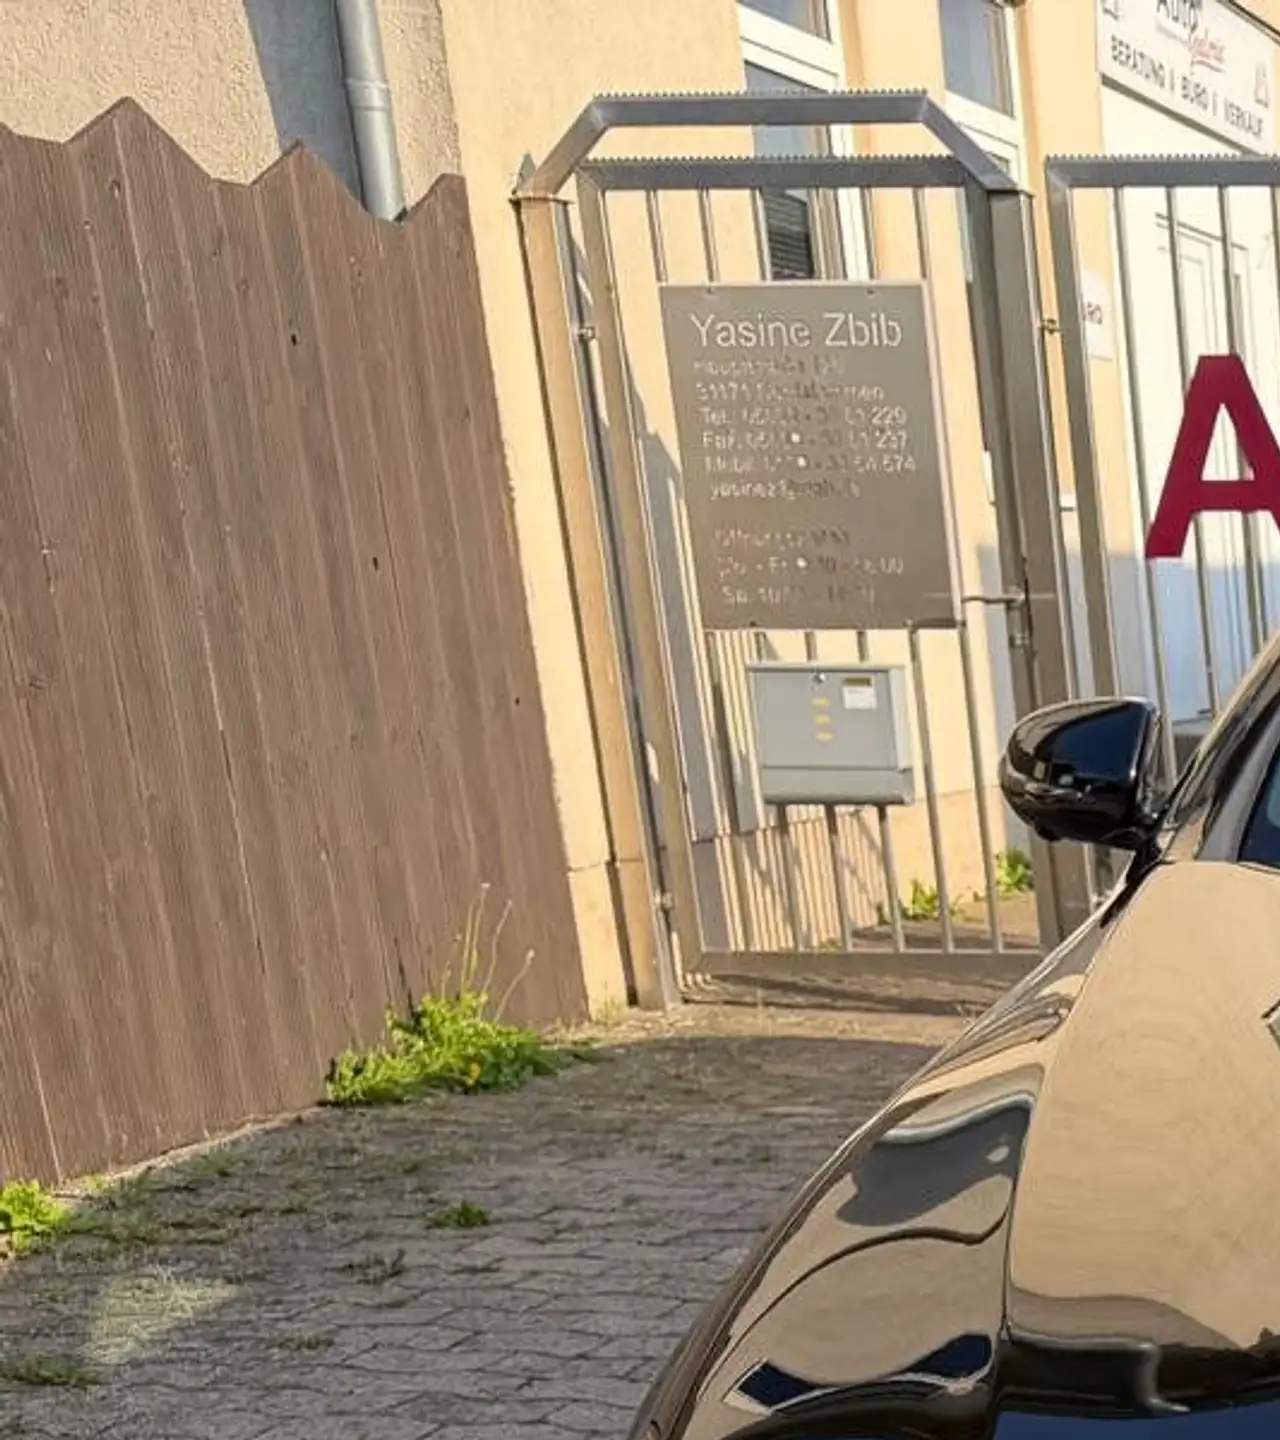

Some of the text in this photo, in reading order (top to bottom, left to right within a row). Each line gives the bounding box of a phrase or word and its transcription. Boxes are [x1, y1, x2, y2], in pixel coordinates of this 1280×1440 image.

[1110, 34, 1166, 88] BERATUNG
[690, 312, 903, 349] Yasine Zbib
